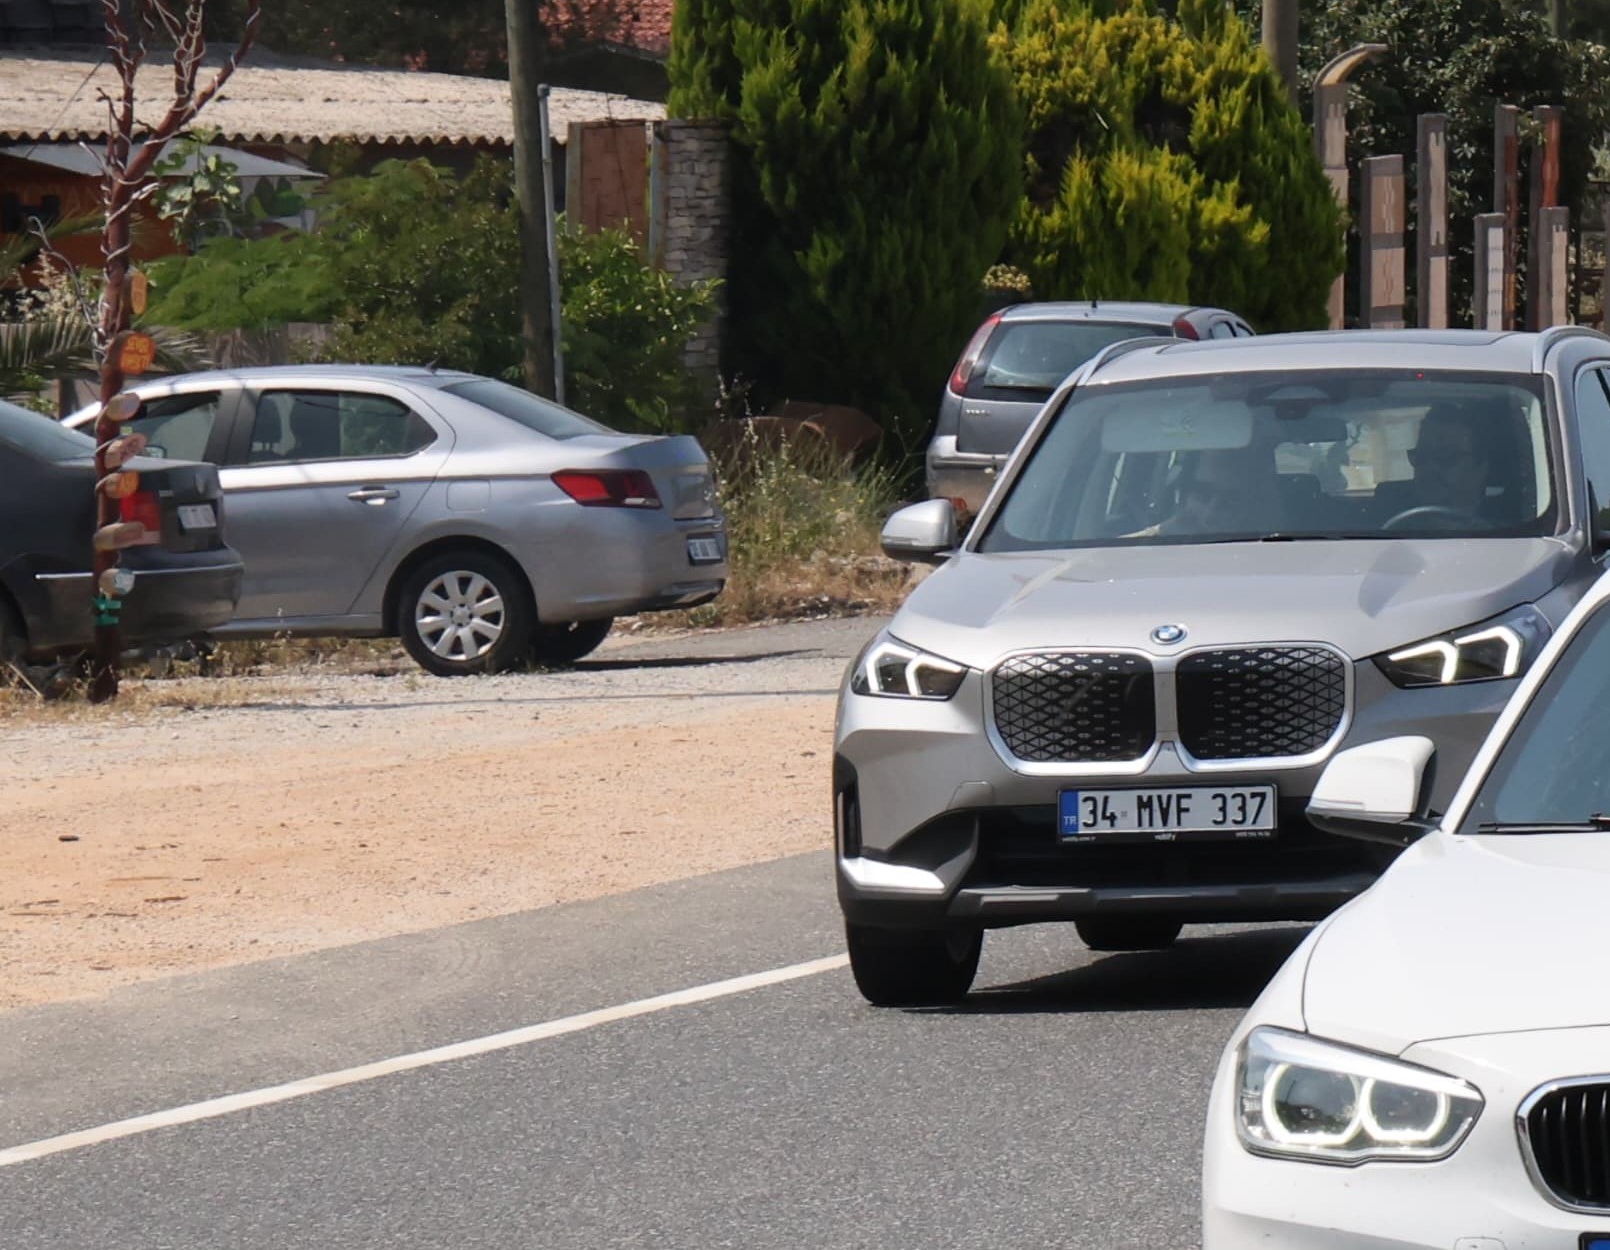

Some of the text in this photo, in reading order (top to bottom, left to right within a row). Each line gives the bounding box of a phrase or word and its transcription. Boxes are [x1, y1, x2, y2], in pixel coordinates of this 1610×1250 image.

[1063, 815, 1077, 826] TR
[1081, 791, 1268, 828] 34 MVF 337
